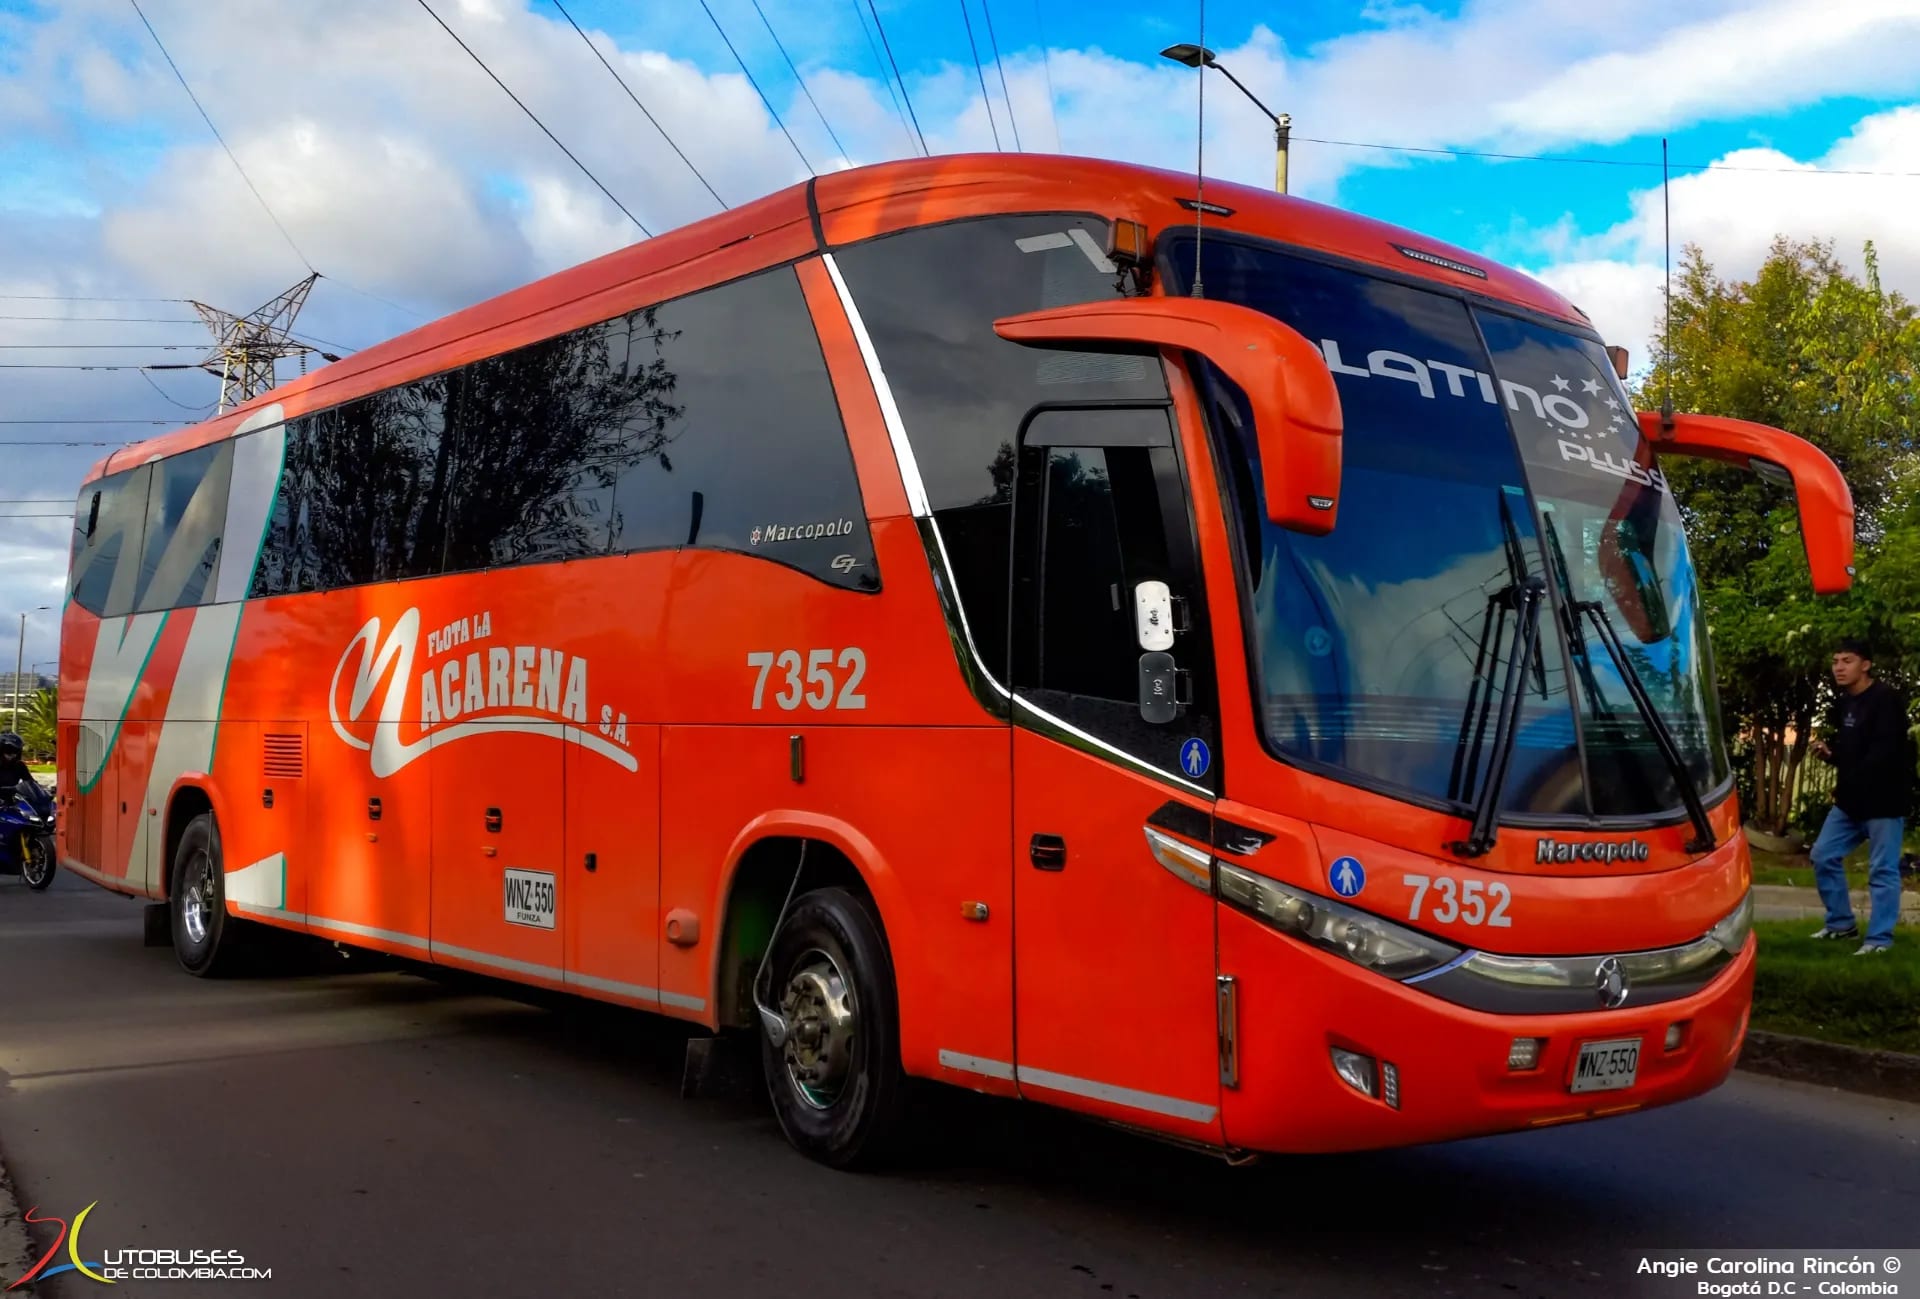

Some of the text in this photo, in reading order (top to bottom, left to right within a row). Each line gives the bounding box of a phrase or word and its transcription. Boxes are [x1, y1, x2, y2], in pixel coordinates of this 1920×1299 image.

[764, 518, 853, 542] Marcopolo
[428, 610, 491, 658] FLOTA LA
[748, 647, 867, 710] 7352
[599, 704, 629, 747] S.A.
[1536, 838, 1648, 864] Marcopolo
[517, 912, 541, 922] FUNZA
[1403, 874, 1512, 927] 7352
